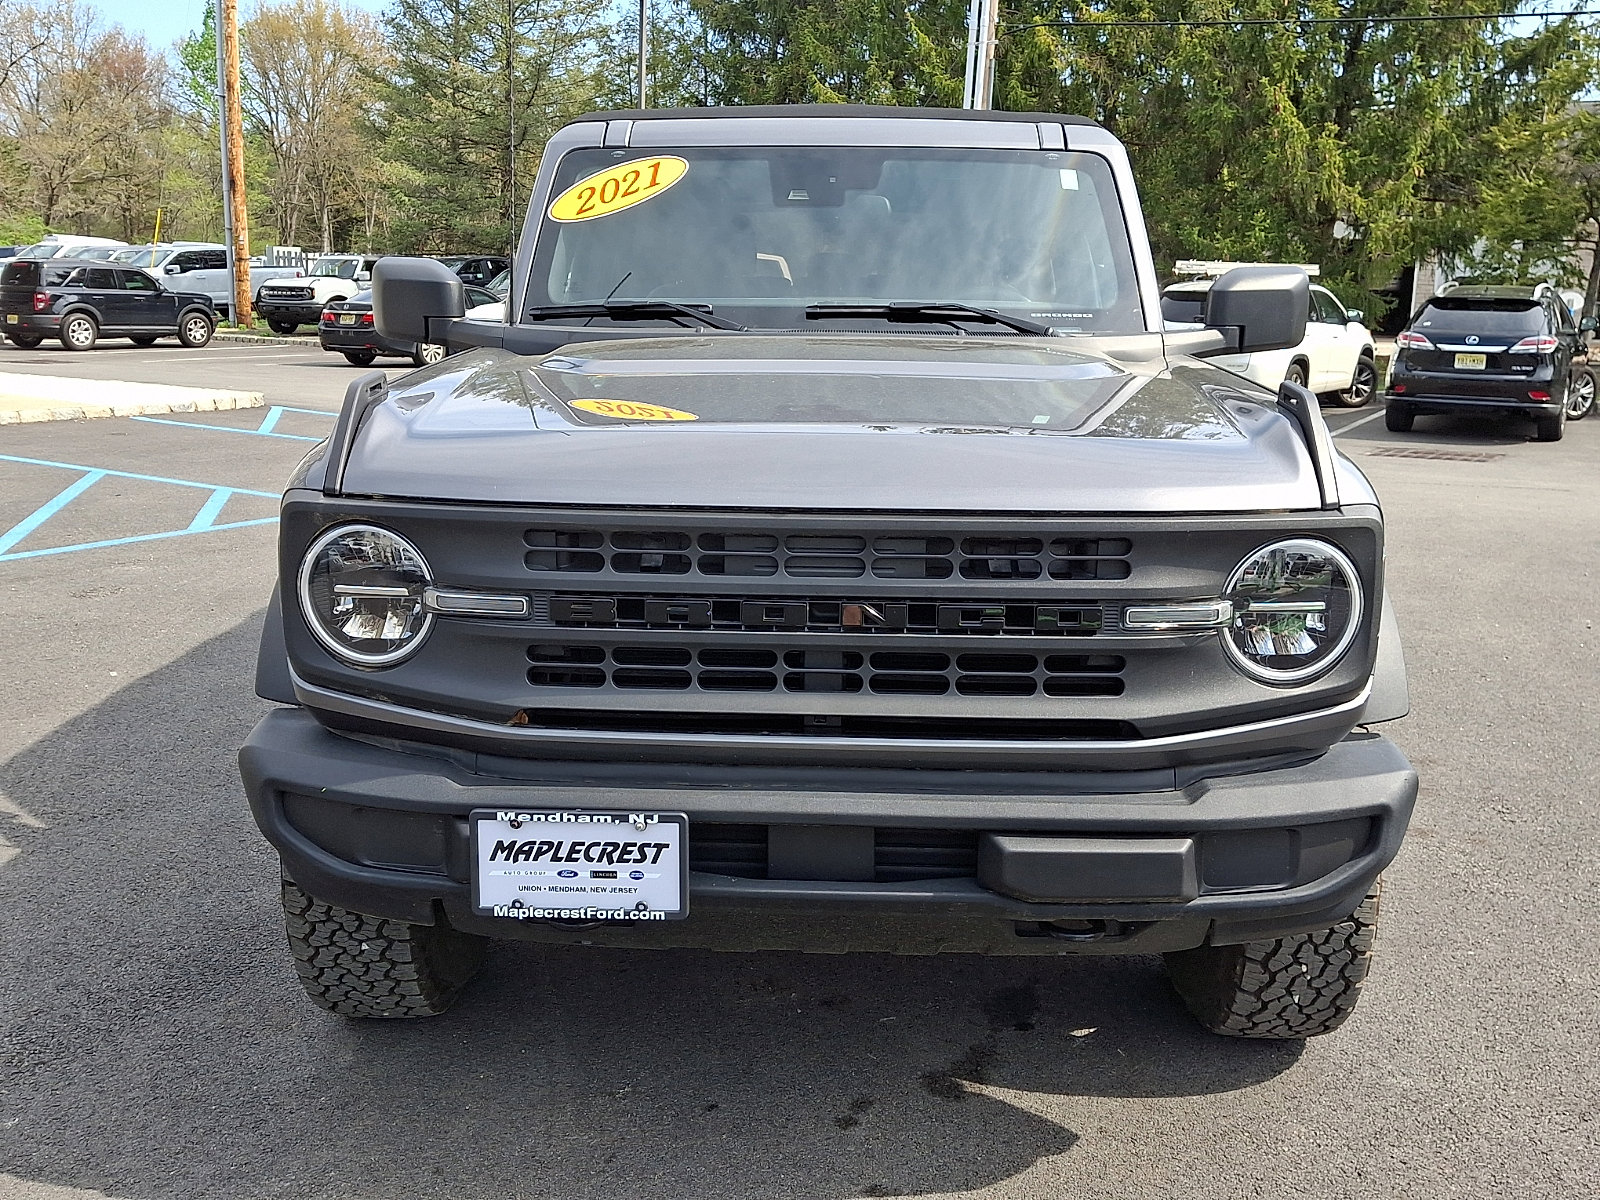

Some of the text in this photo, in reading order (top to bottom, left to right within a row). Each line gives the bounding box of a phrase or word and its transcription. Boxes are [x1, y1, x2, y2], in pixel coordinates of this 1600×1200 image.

[575, 161, 661, 216] 2021
[549, 597, 1102, 630] BRONCO
[496, 811, 659, 825] Mendham, NJ
[488, 839, 670, 865] MAPLECREST
[548, 886, 589, 894] MENDHAM,
[493, 905, 665, 921] MaplecrestFord.com
